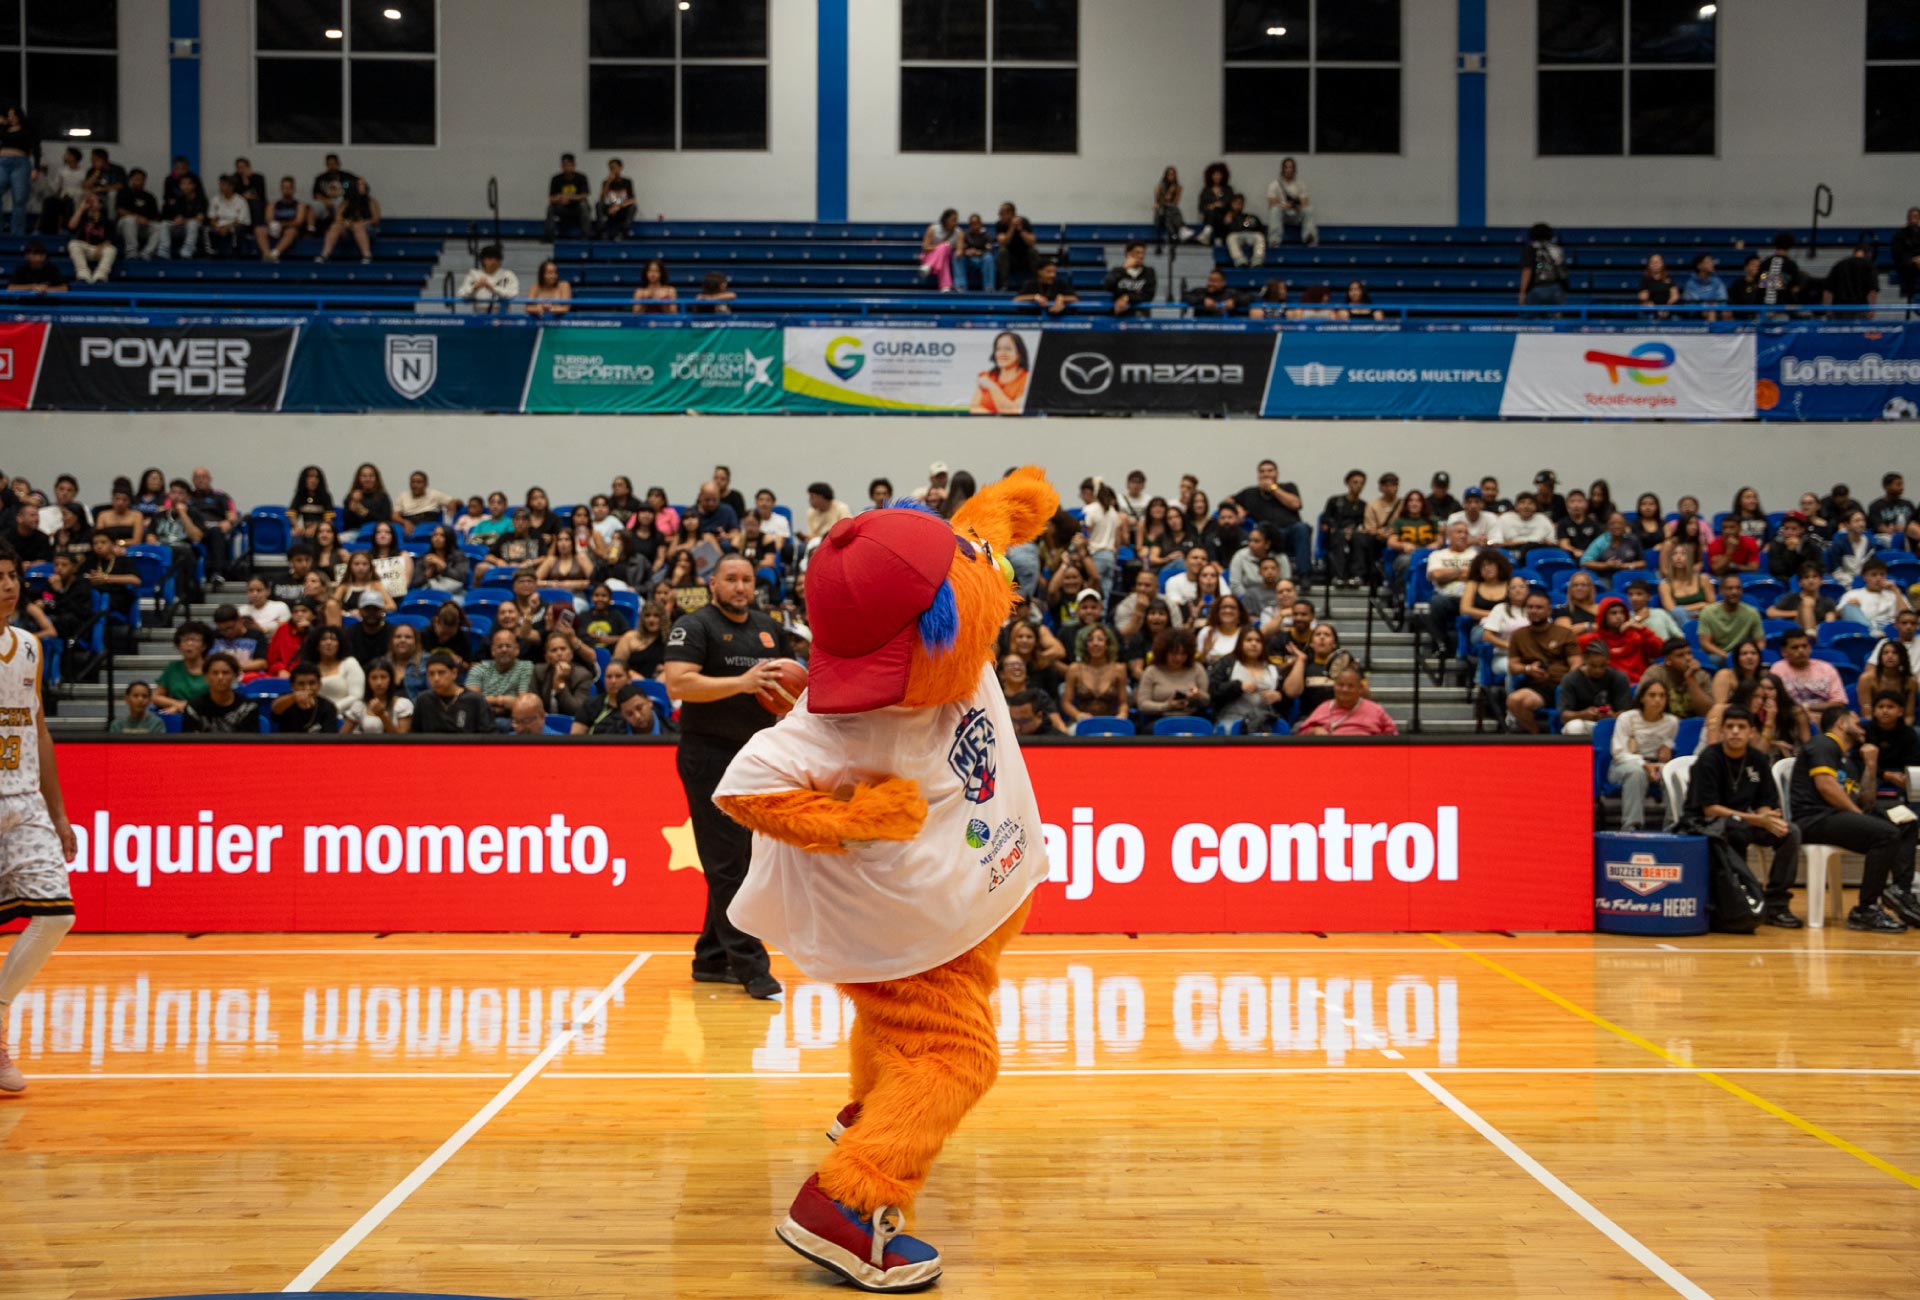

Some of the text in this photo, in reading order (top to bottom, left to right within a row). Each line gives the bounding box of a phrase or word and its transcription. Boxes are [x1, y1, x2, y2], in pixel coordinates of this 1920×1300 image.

[80, 338, 251, 367] POWER
[873, 341, 956, 357] GURABO
[554, 355, 604, 365] TURISMO
[553, 365, 655, 380] DEPORTIVO
[670, 361, 743, 380] TOURISM
[1120, 364, 1244, 384] mazda
[1348, 369, 1503, 383] SEGUROS MULTIPLES
[150, 367, 247, 395] ADE
[1584, 393, 1677, 408] TotalEnergies
[303, 813, 627, 887] momento,
[1171, 806, 1458, 884] control
[1663, 897, 1697, 917] HERE!
